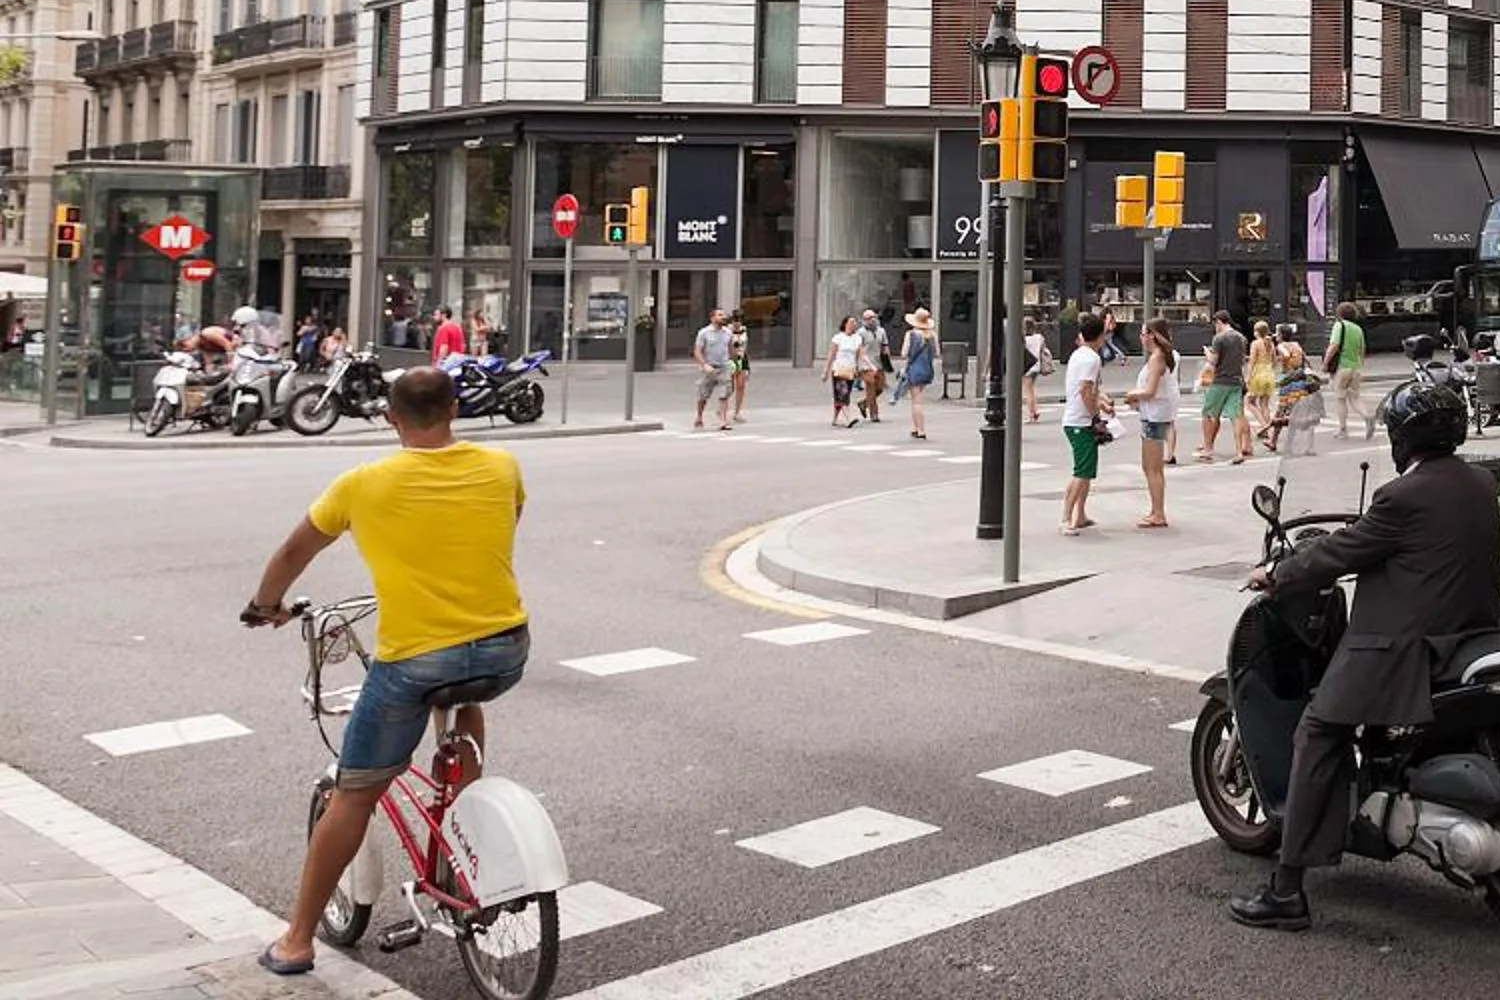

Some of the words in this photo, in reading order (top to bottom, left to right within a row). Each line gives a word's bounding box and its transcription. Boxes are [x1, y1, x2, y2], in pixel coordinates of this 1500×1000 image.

[677, 220, 717, 232] MONT
[159, 225, 193, 249] M
[677, 231, 717, 243] BLANC
[1433, 232, 1472, 243] RABAT
